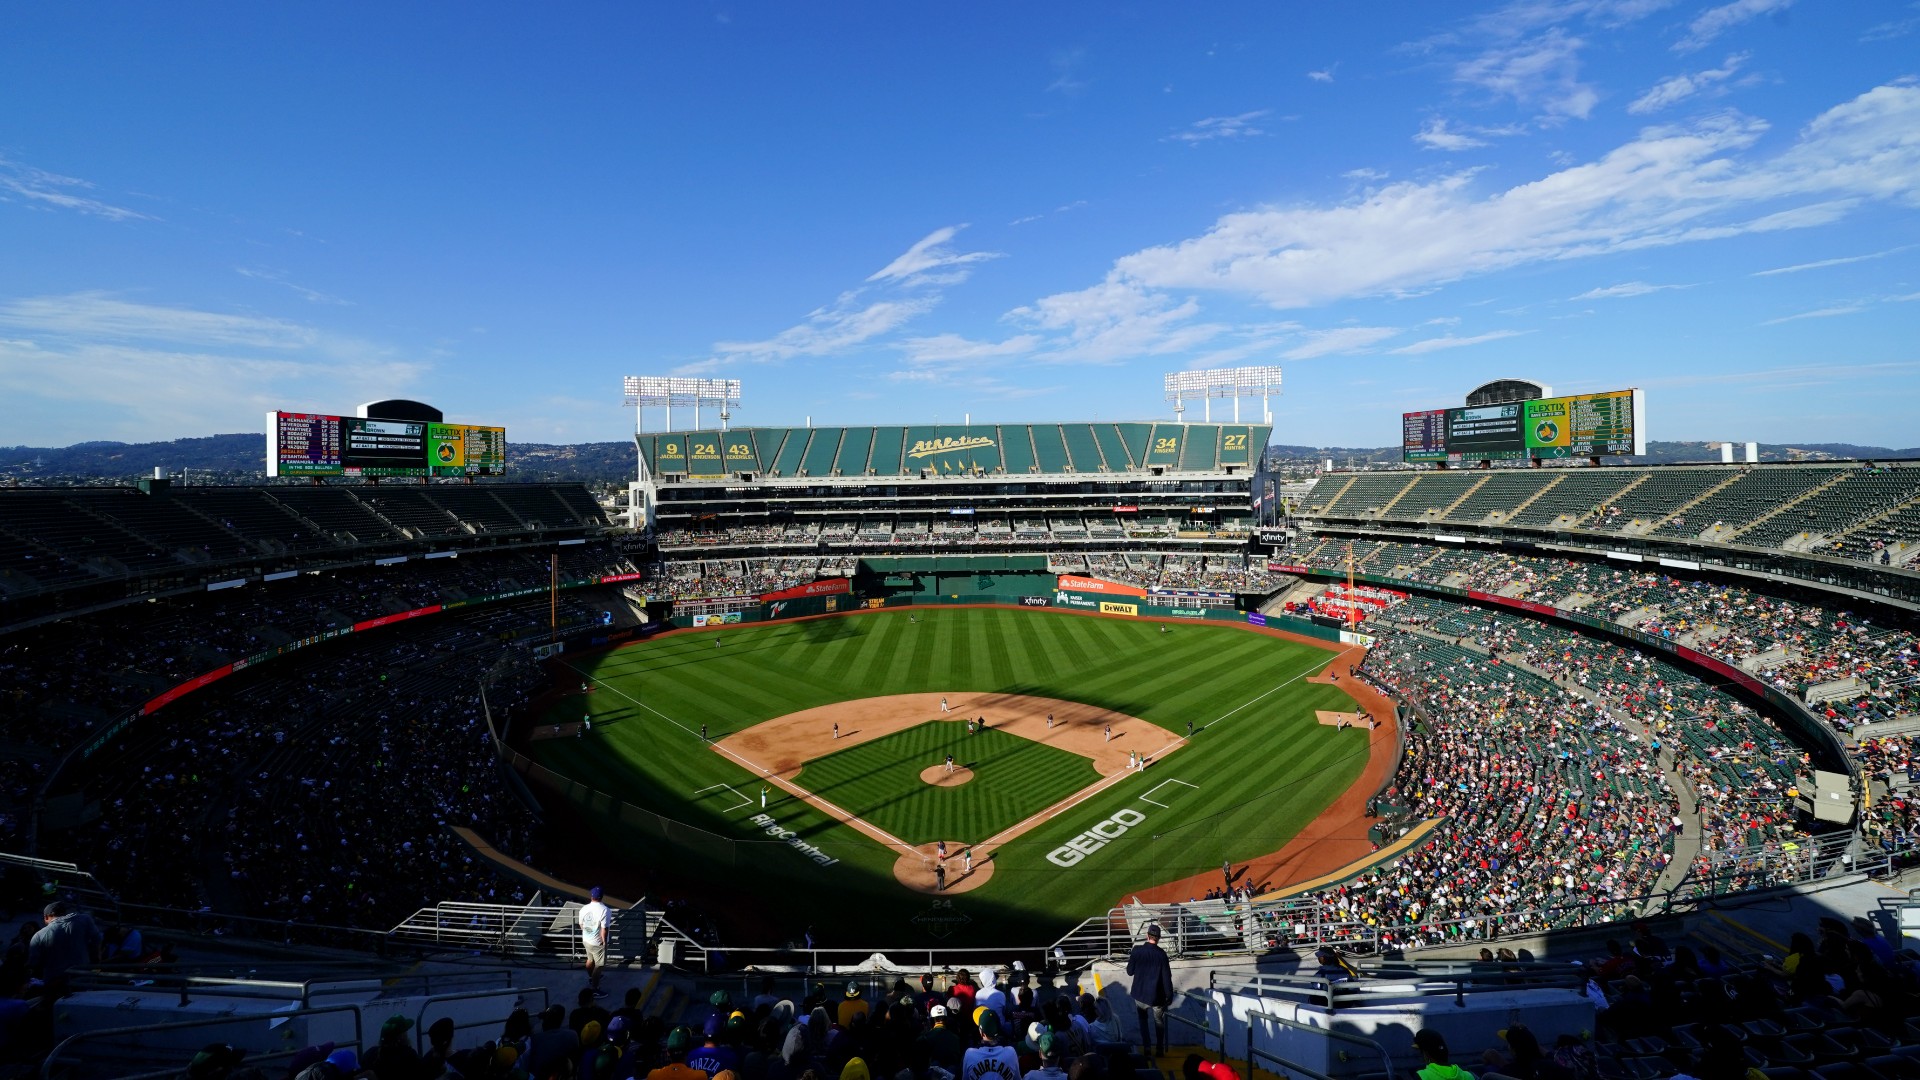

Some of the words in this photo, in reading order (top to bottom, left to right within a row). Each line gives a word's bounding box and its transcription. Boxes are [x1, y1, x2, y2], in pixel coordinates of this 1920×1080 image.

[1528, 402, 1565, 413] FLEXTIX
[1156, 438, 1176, 448] 34
[1225, 434, 1246, 446] 27
[666, 444, 678, 454] 9
[694, 444, 715, 454] 24
[729, 444, 750, 455] 43
[908, 436, 995, 458] Athletics
[1571, 446, 1594, 454] MILLERS
[1608, 444, 1631, 452] MILLERS
[1262, 532, 1286, 542] xfinity
[623, 542, 646, 551] xfinity
[1024, 596, 1047, 606] xfinity
[748, 813, 840, 868] RingCentral
[1046, 808, 1146, 868] GEICO
[932, 900, 952, 910] 24
[690, 1058, 720, 1074] PIAZZA
